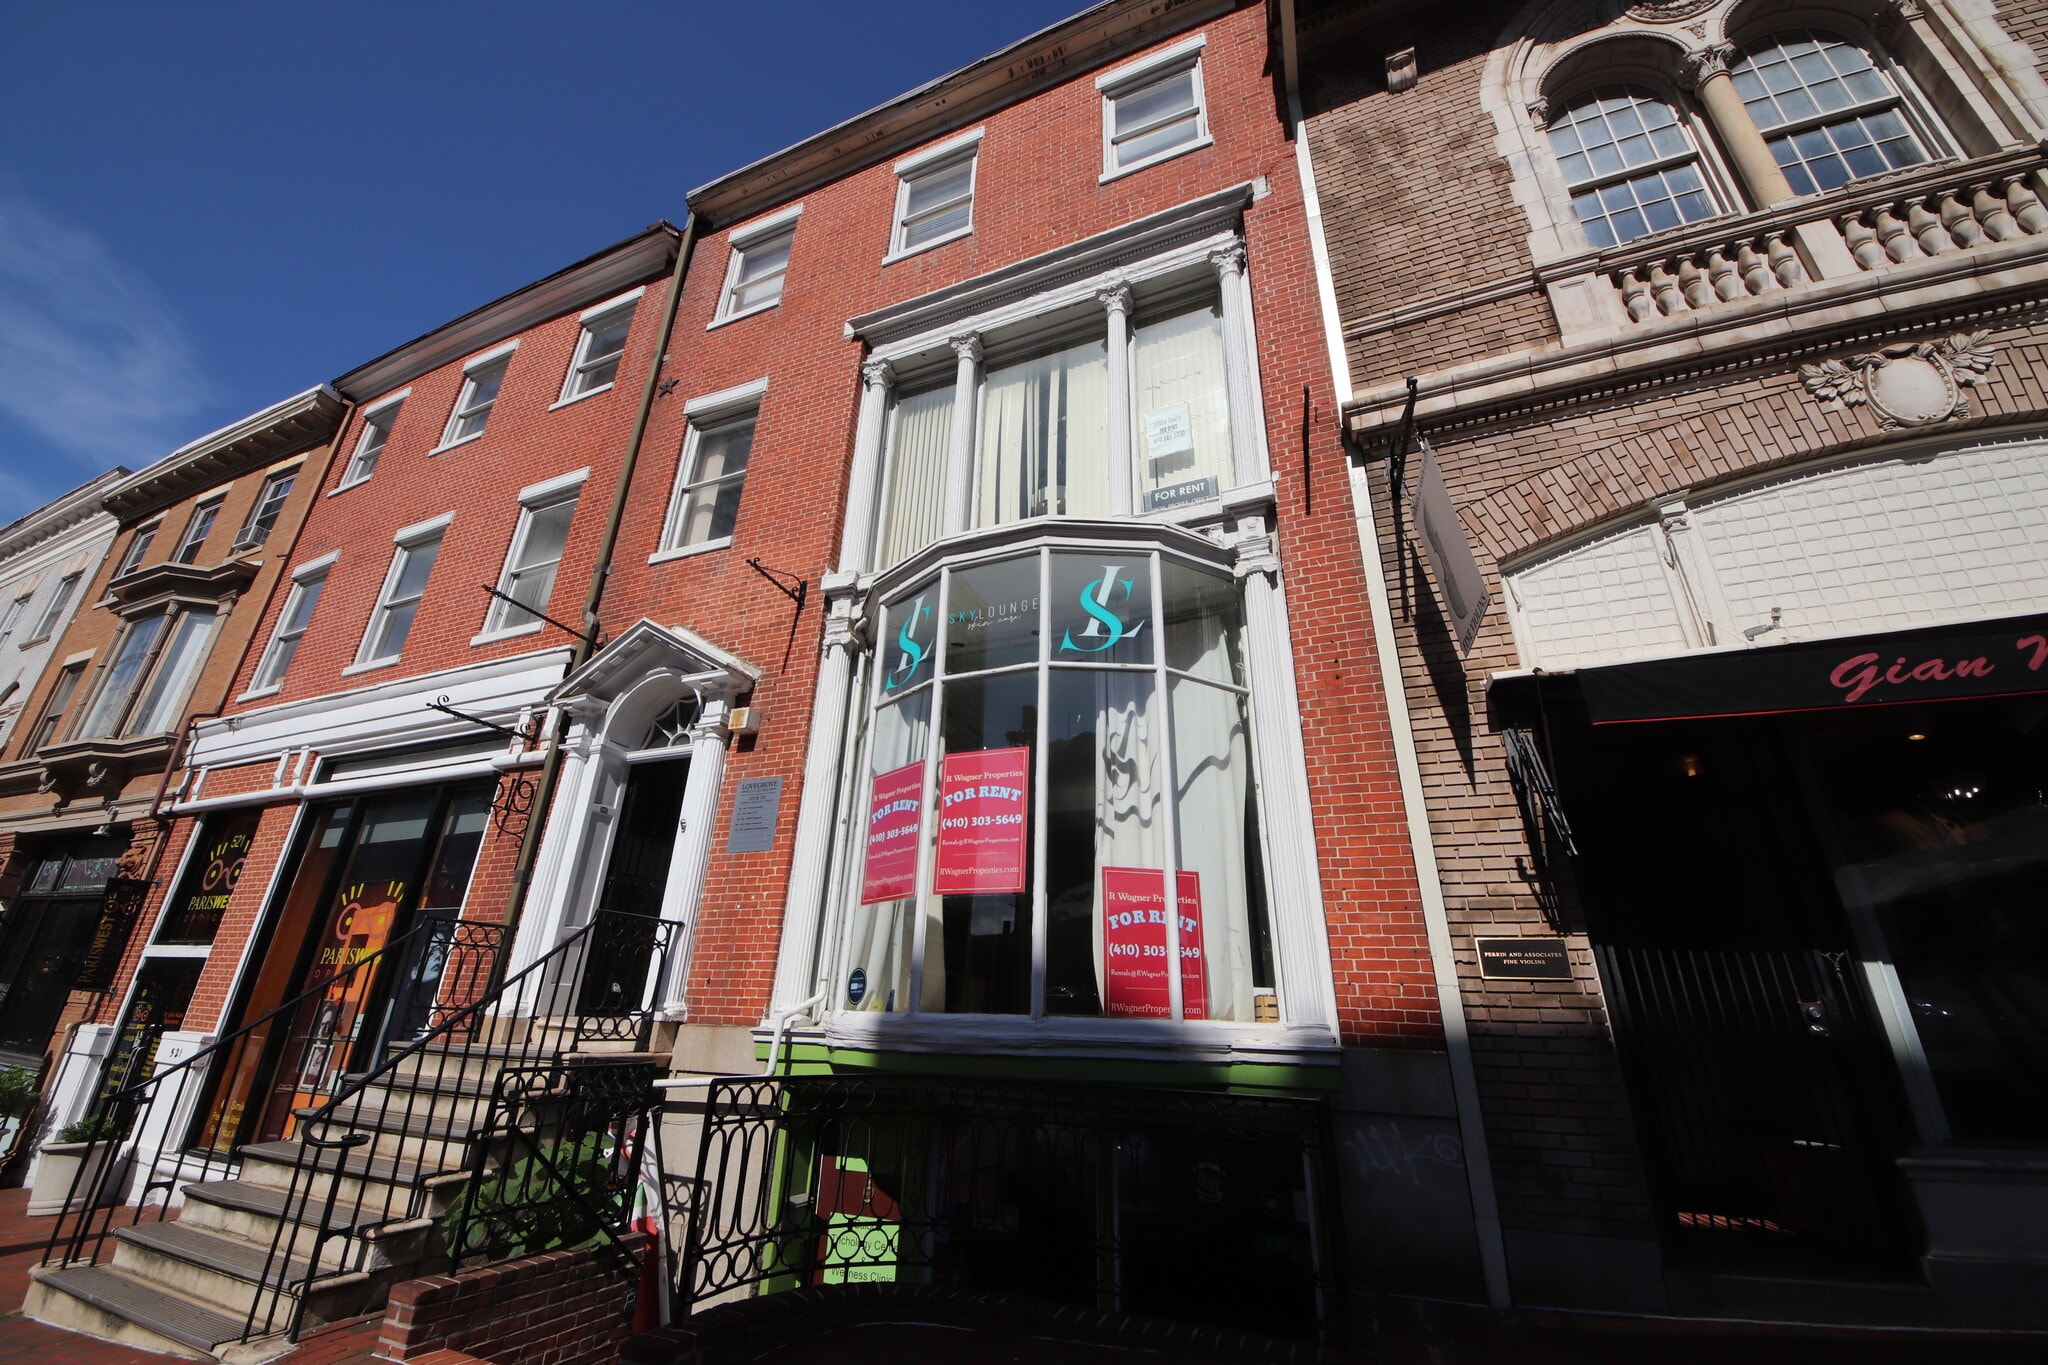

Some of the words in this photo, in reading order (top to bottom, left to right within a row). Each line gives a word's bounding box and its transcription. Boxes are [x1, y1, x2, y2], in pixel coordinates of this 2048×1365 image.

[1155, 489, 1176, 502] FOR
[1179, 482, 1206, 496] RENT
[1462, 628, 1473, 653] FINE
[1469, 592, 1487, 632] VIOLINS
[1829, 652, 1996, 703] Gian
[946, 775, 952, 783] R
[954, 774, 982, 784] Wagner
[983, 769, 1024, 781] Properties
[741, 780, 779, 791] LOVEGROVE
[896, 782, 921, 795] Properties
[944, 787, 976, 807] FOR
[978, 785, 1023, 802] RENT
[871, 803, 892, 824] FOR
[892, 799, 920, 812] RENT
[942, 817, 968, 830] (410)
[971, 814, 1023, 827] 303-5649
[230, 834, 247, 849] 521
[869, 832, 886, 846] (410)
[886, 823, 918, 840] 303-5649
[939, 866, 1019, 878] RWagnerProperties.com
[1108, 892, 1116, 900] R
[1117, 892, 1151, 904] Wagner
[1108, 910, 1146, 930] FOR
[76, 915, 117, 984] PARISWEST
[1109, 943, 1140, 959] (410)
[169, 1047, 184, 1058] 521
